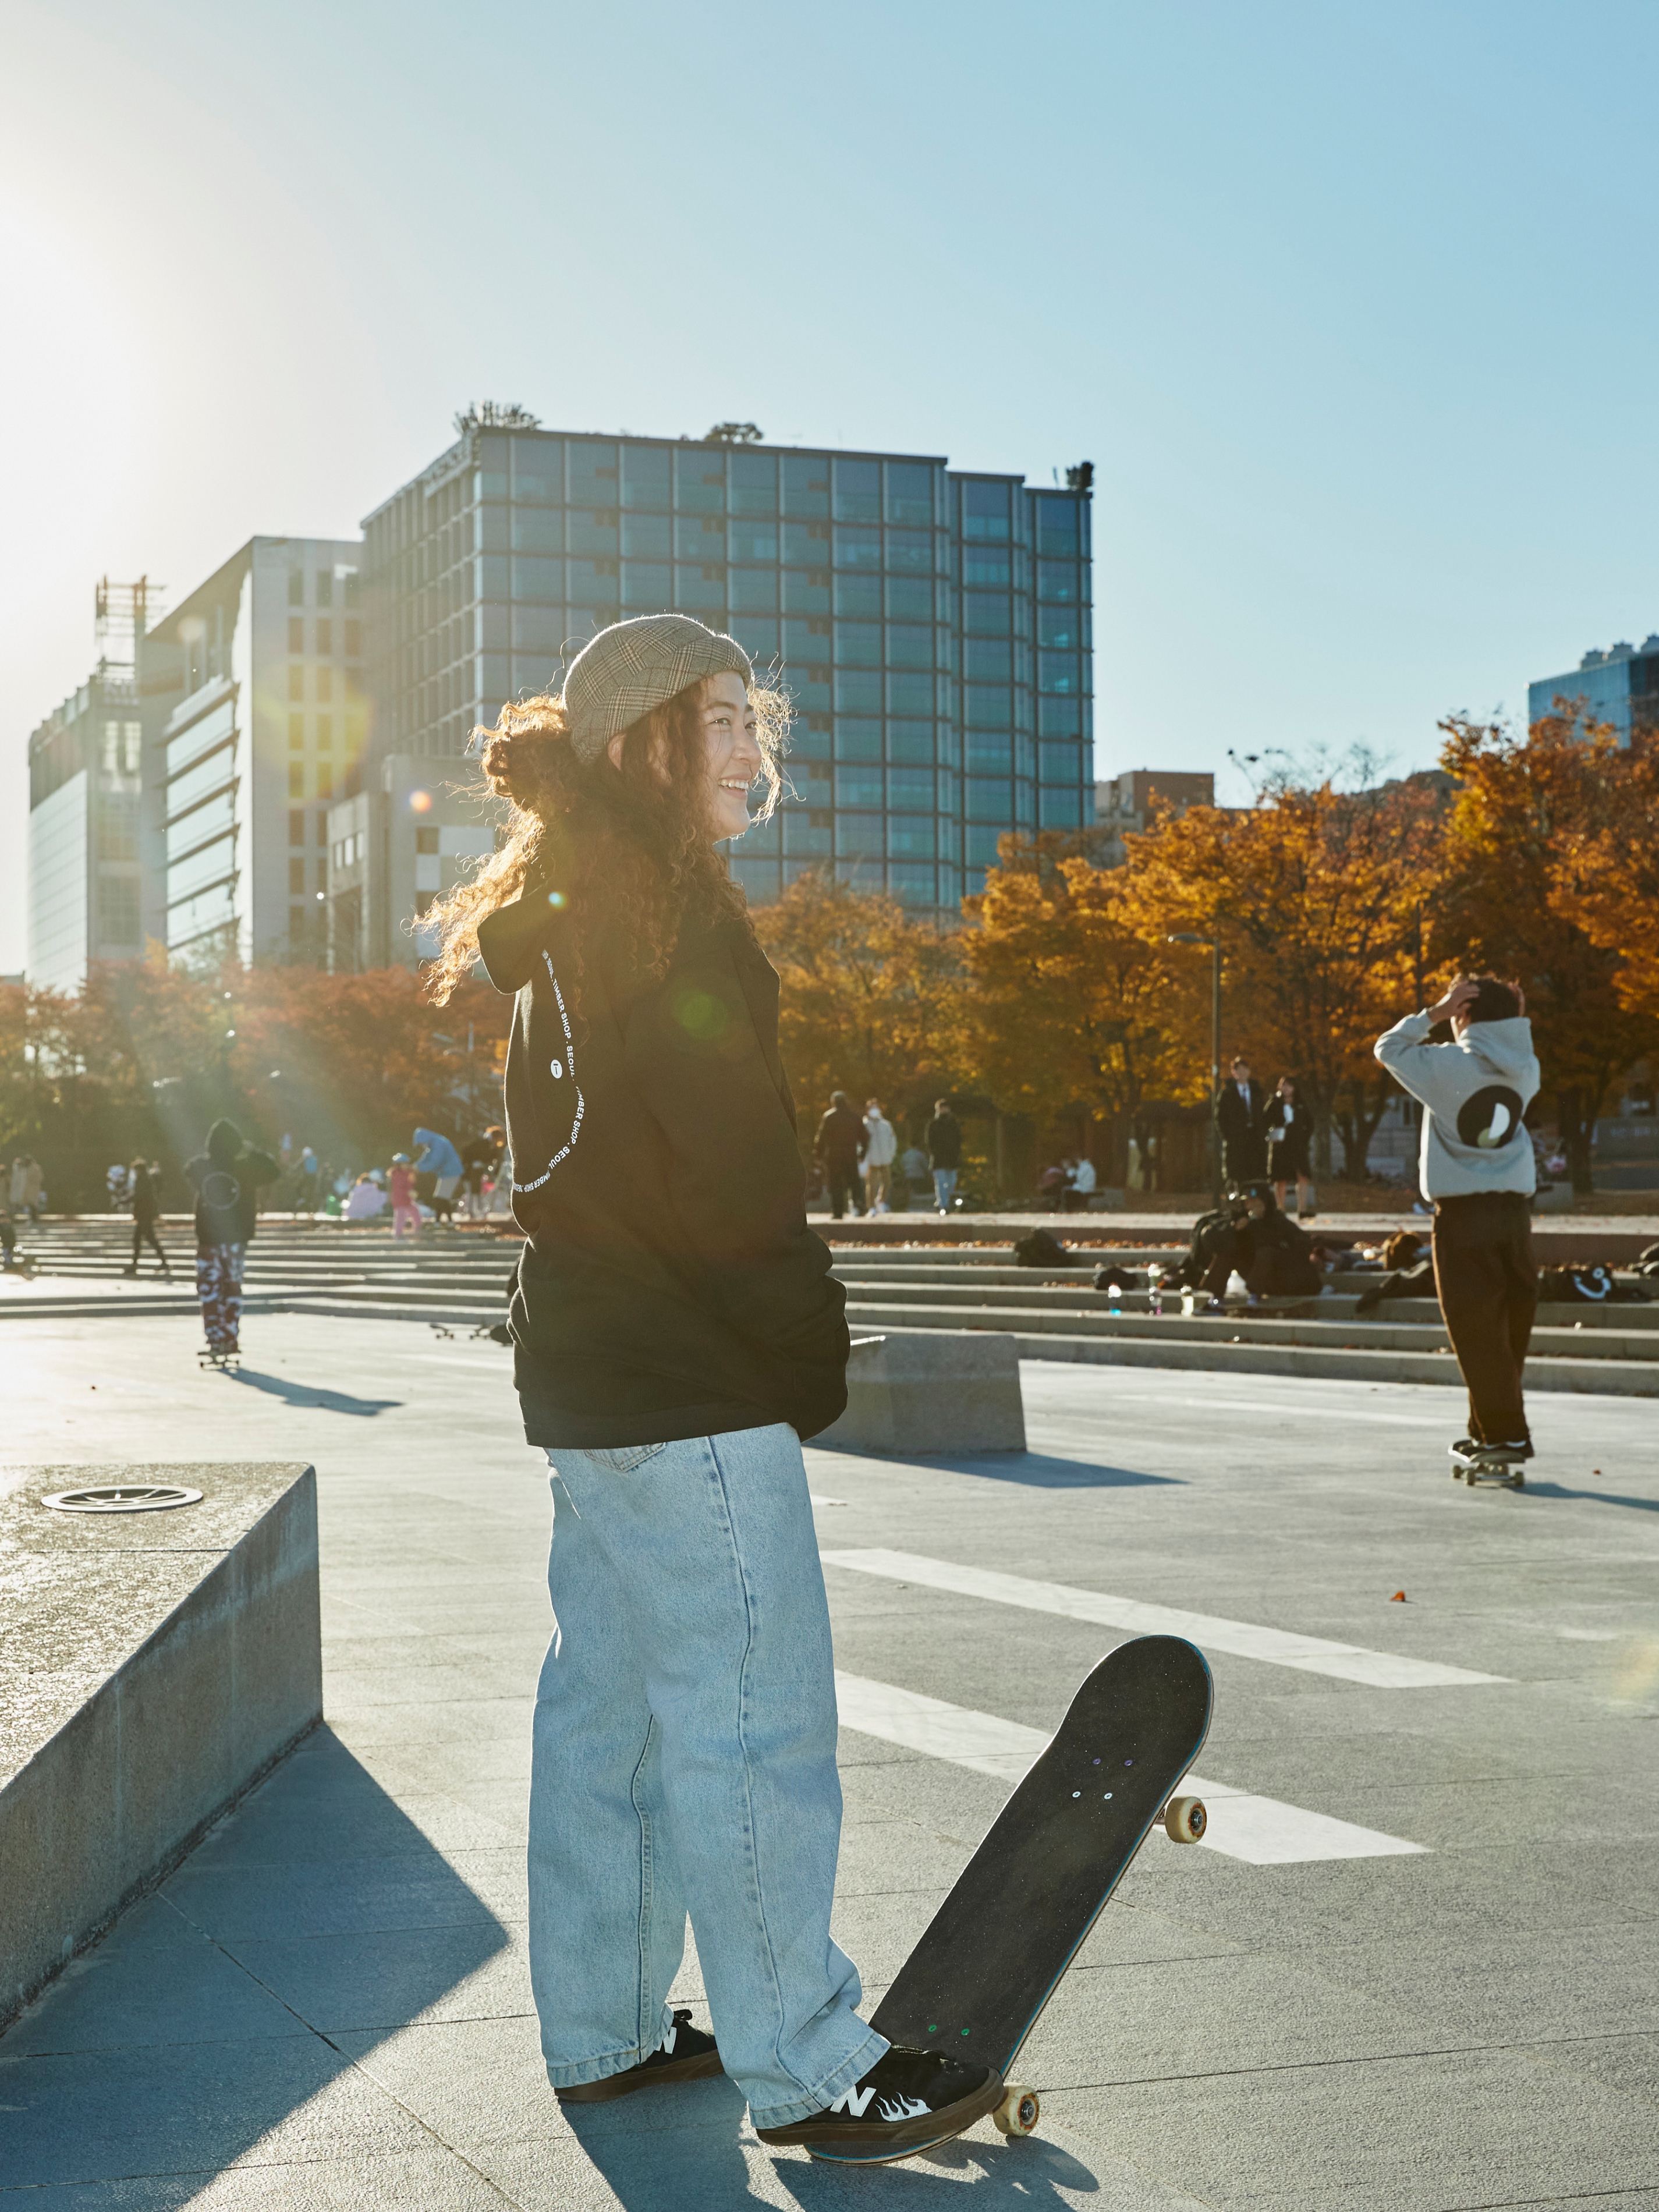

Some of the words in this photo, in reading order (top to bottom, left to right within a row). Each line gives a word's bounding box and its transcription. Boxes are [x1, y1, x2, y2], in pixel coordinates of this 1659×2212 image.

[552, 979, 565, 1012] TIMBER
[561, 1013, 572, 1039] SHOP
[566, 1045, 575, 1077] SEOUL
[570, 1120, 581, 1144] SHOP
[548, 1146, 570, 1169] SEOUL
[830, 2085, 877, 2117] N
